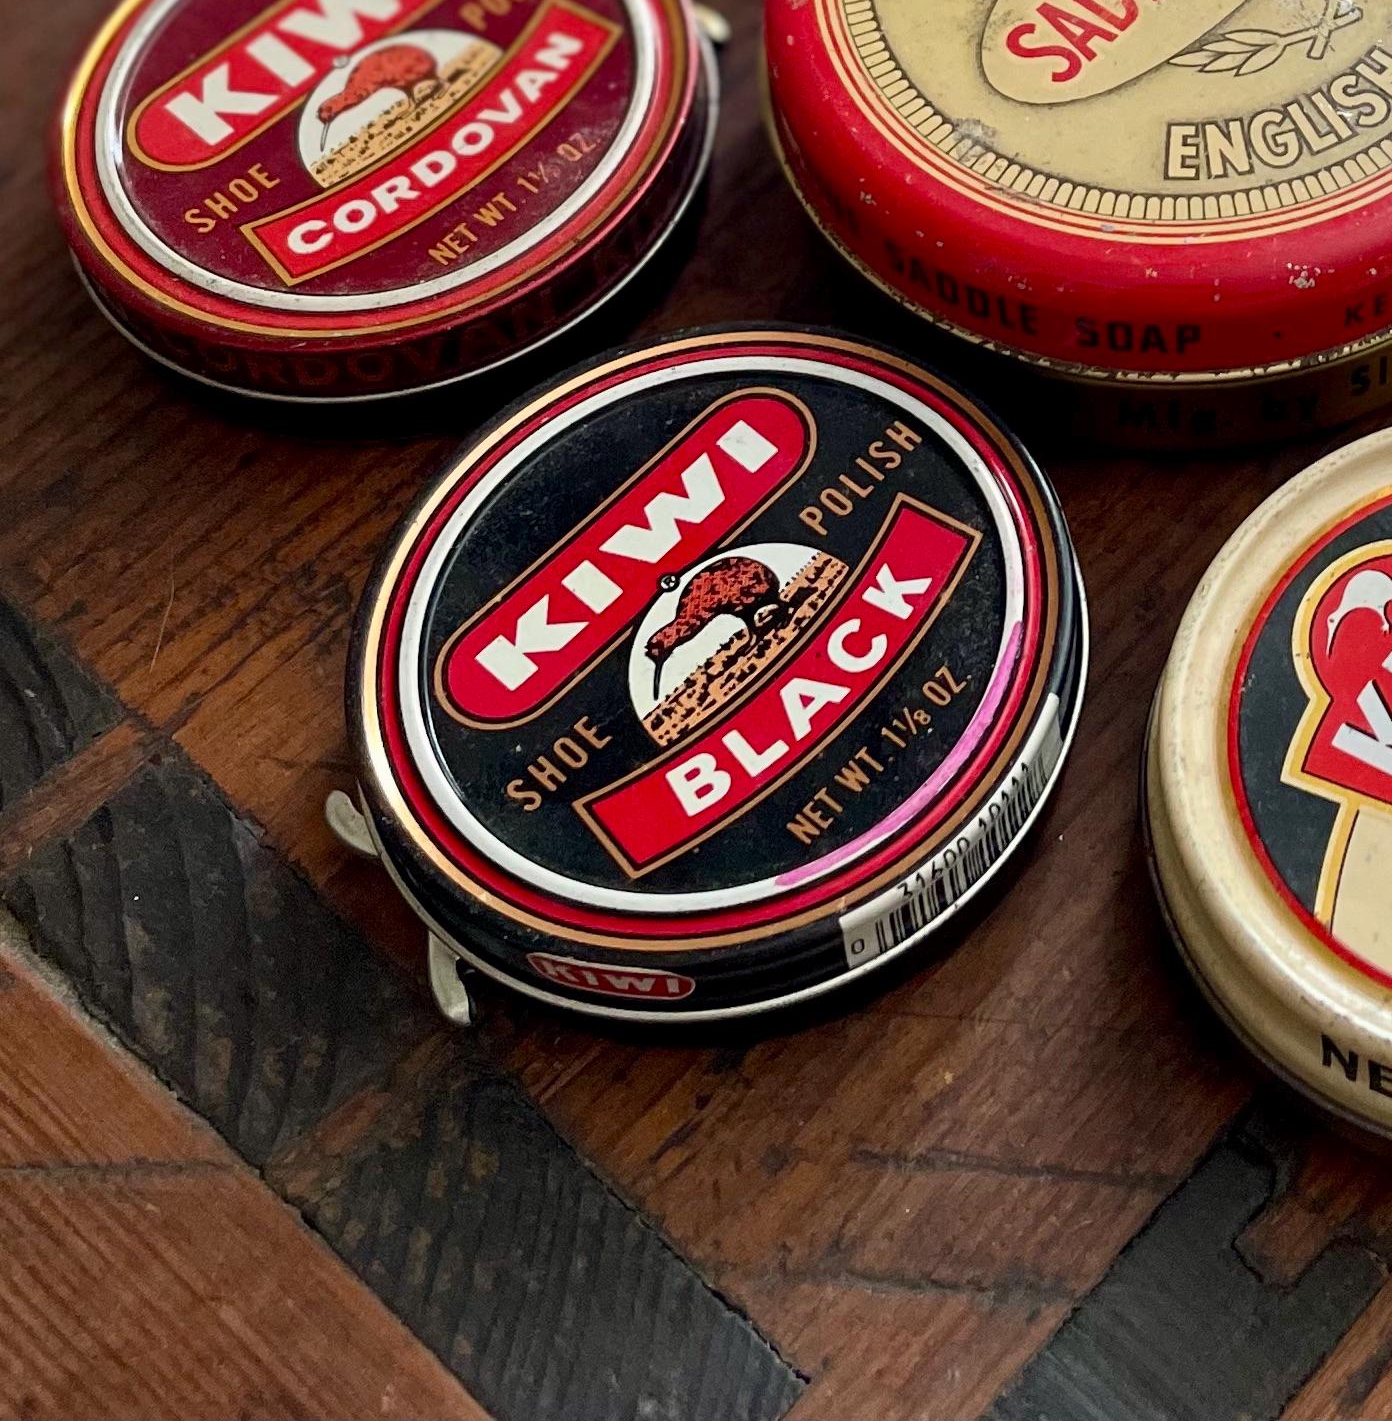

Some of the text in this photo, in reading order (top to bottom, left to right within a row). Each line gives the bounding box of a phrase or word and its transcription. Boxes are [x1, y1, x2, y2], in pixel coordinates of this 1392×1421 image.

[287, 32, 582, 257] CORDOVAN
[183, 163, 280, 236] SHOE
[428, 223, 478, 267] NET
[1075, 316, 1202, 357] SOAP
[475, 420, 778, 691] KIWI
[506, 421, 923, 813] SHOE POLISH
[665, 563, 933, 818] BLACK
[786, 787, 842, 845] NET
[540, 959, 680, 994] KIWI
